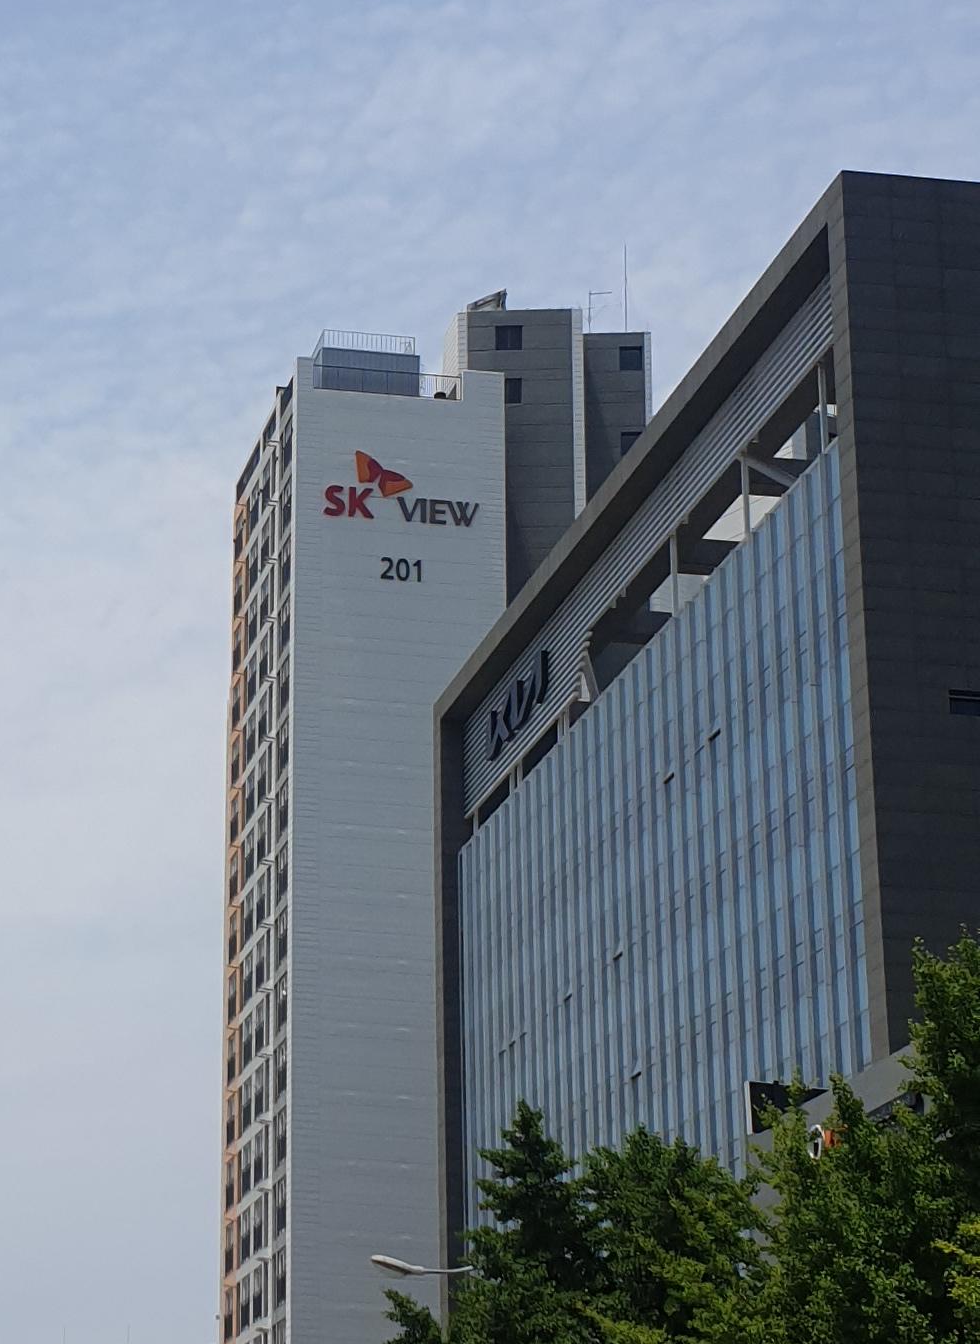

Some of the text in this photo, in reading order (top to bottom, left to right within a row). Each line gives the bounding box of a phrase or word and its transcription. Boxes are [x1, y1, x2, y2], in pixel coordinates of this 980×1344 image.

[323, 484, 480, 527] SK VIEW
[380, 557, 423, 583] 201
